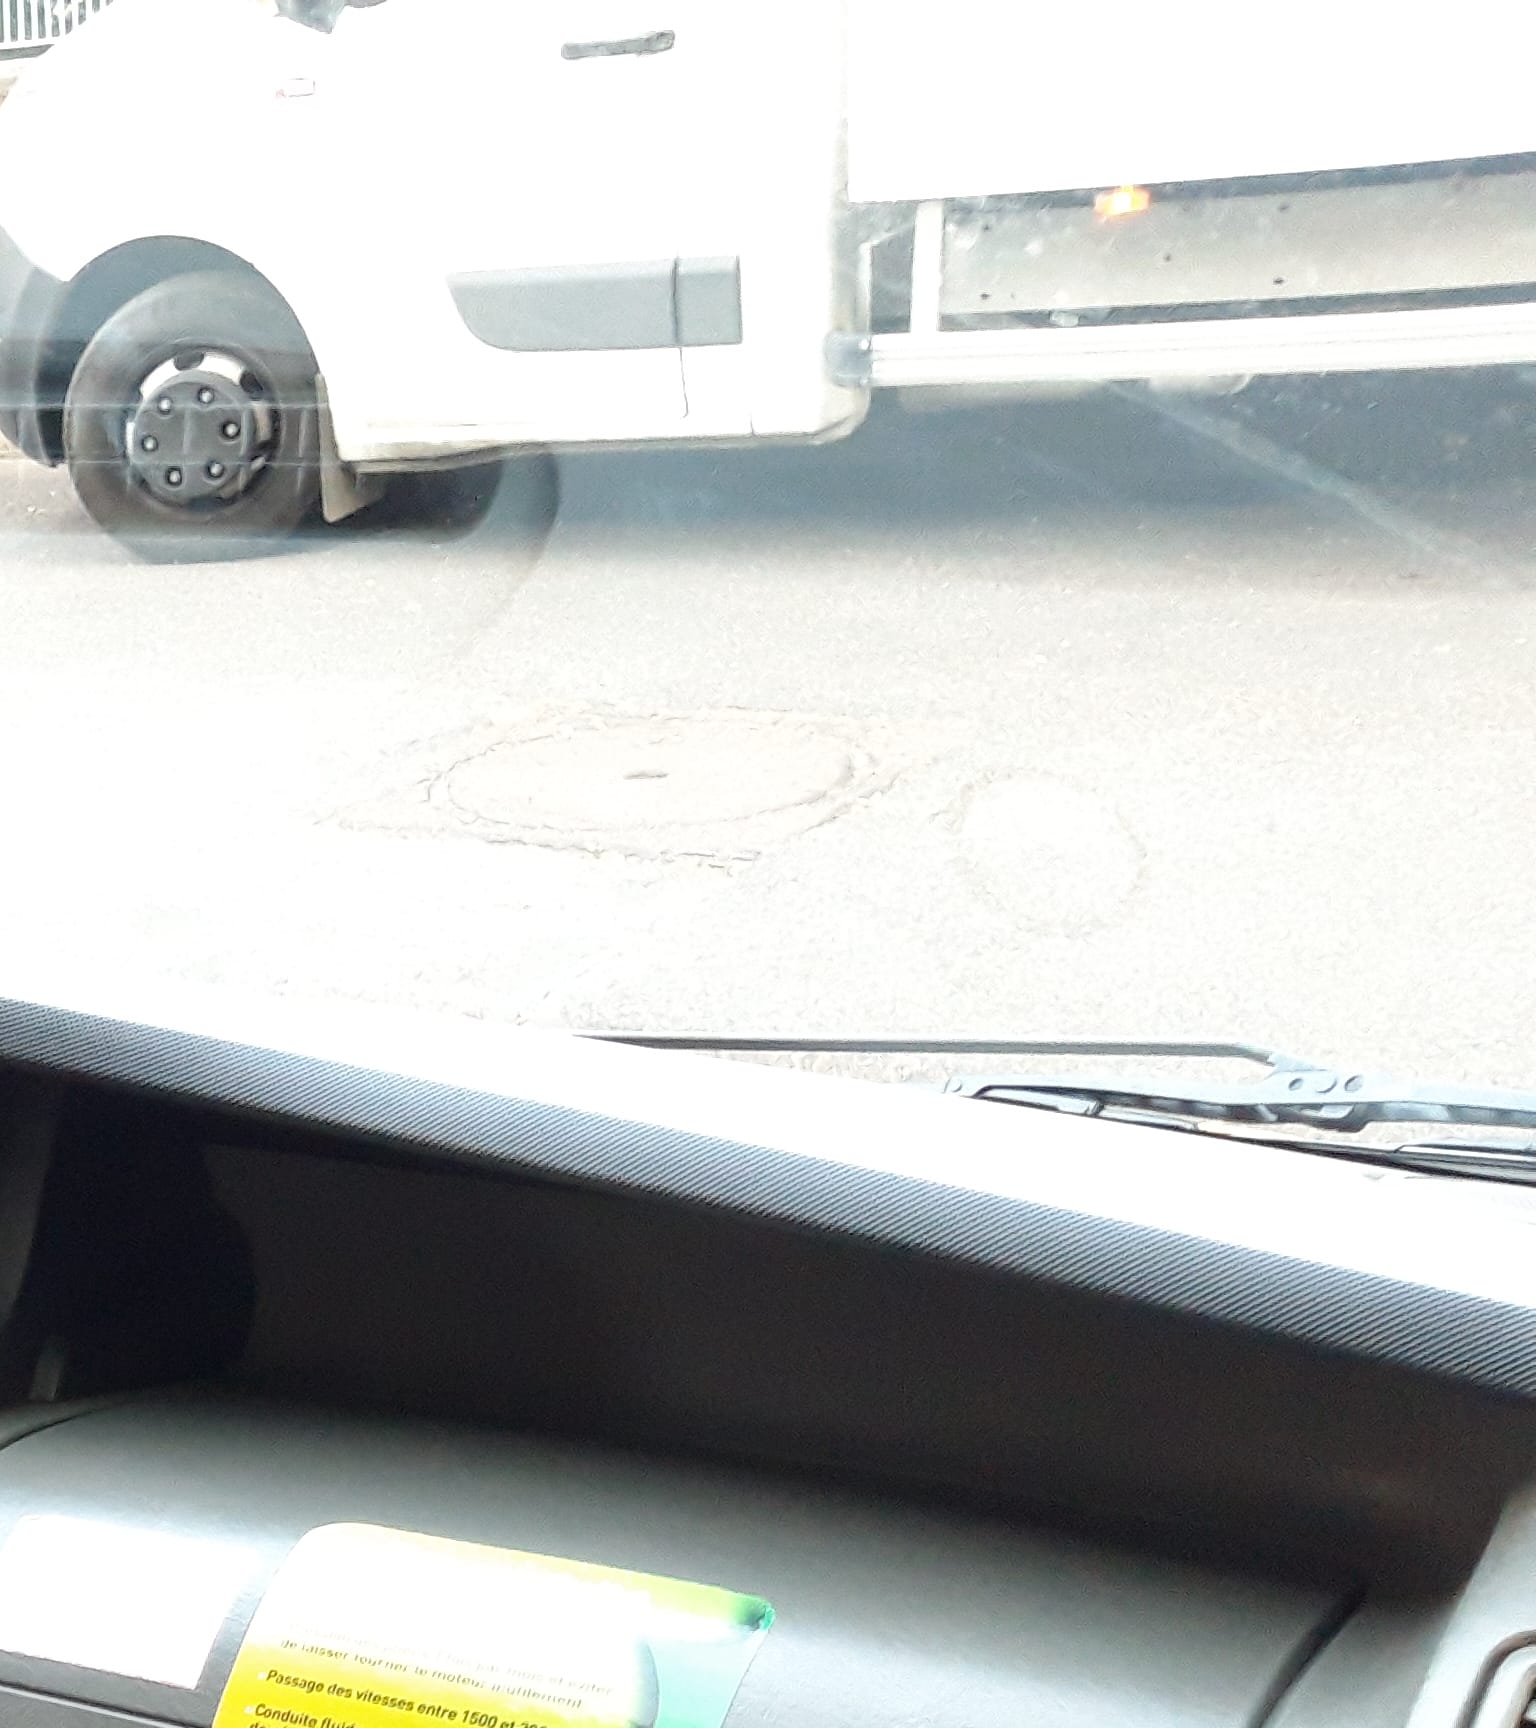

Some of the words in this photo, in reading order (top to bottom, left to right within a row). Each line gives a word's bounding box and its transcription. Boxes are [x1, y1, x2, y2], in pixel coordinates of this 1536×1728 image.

[265, 1669, 324, 1694] Passage
[327, 1681, 353, 1699] des
[355, 1688, 415, 1713] vitesses
[417, 1702, 458, 1721] entre
[254, 1703, 318, 1728] Conduite
